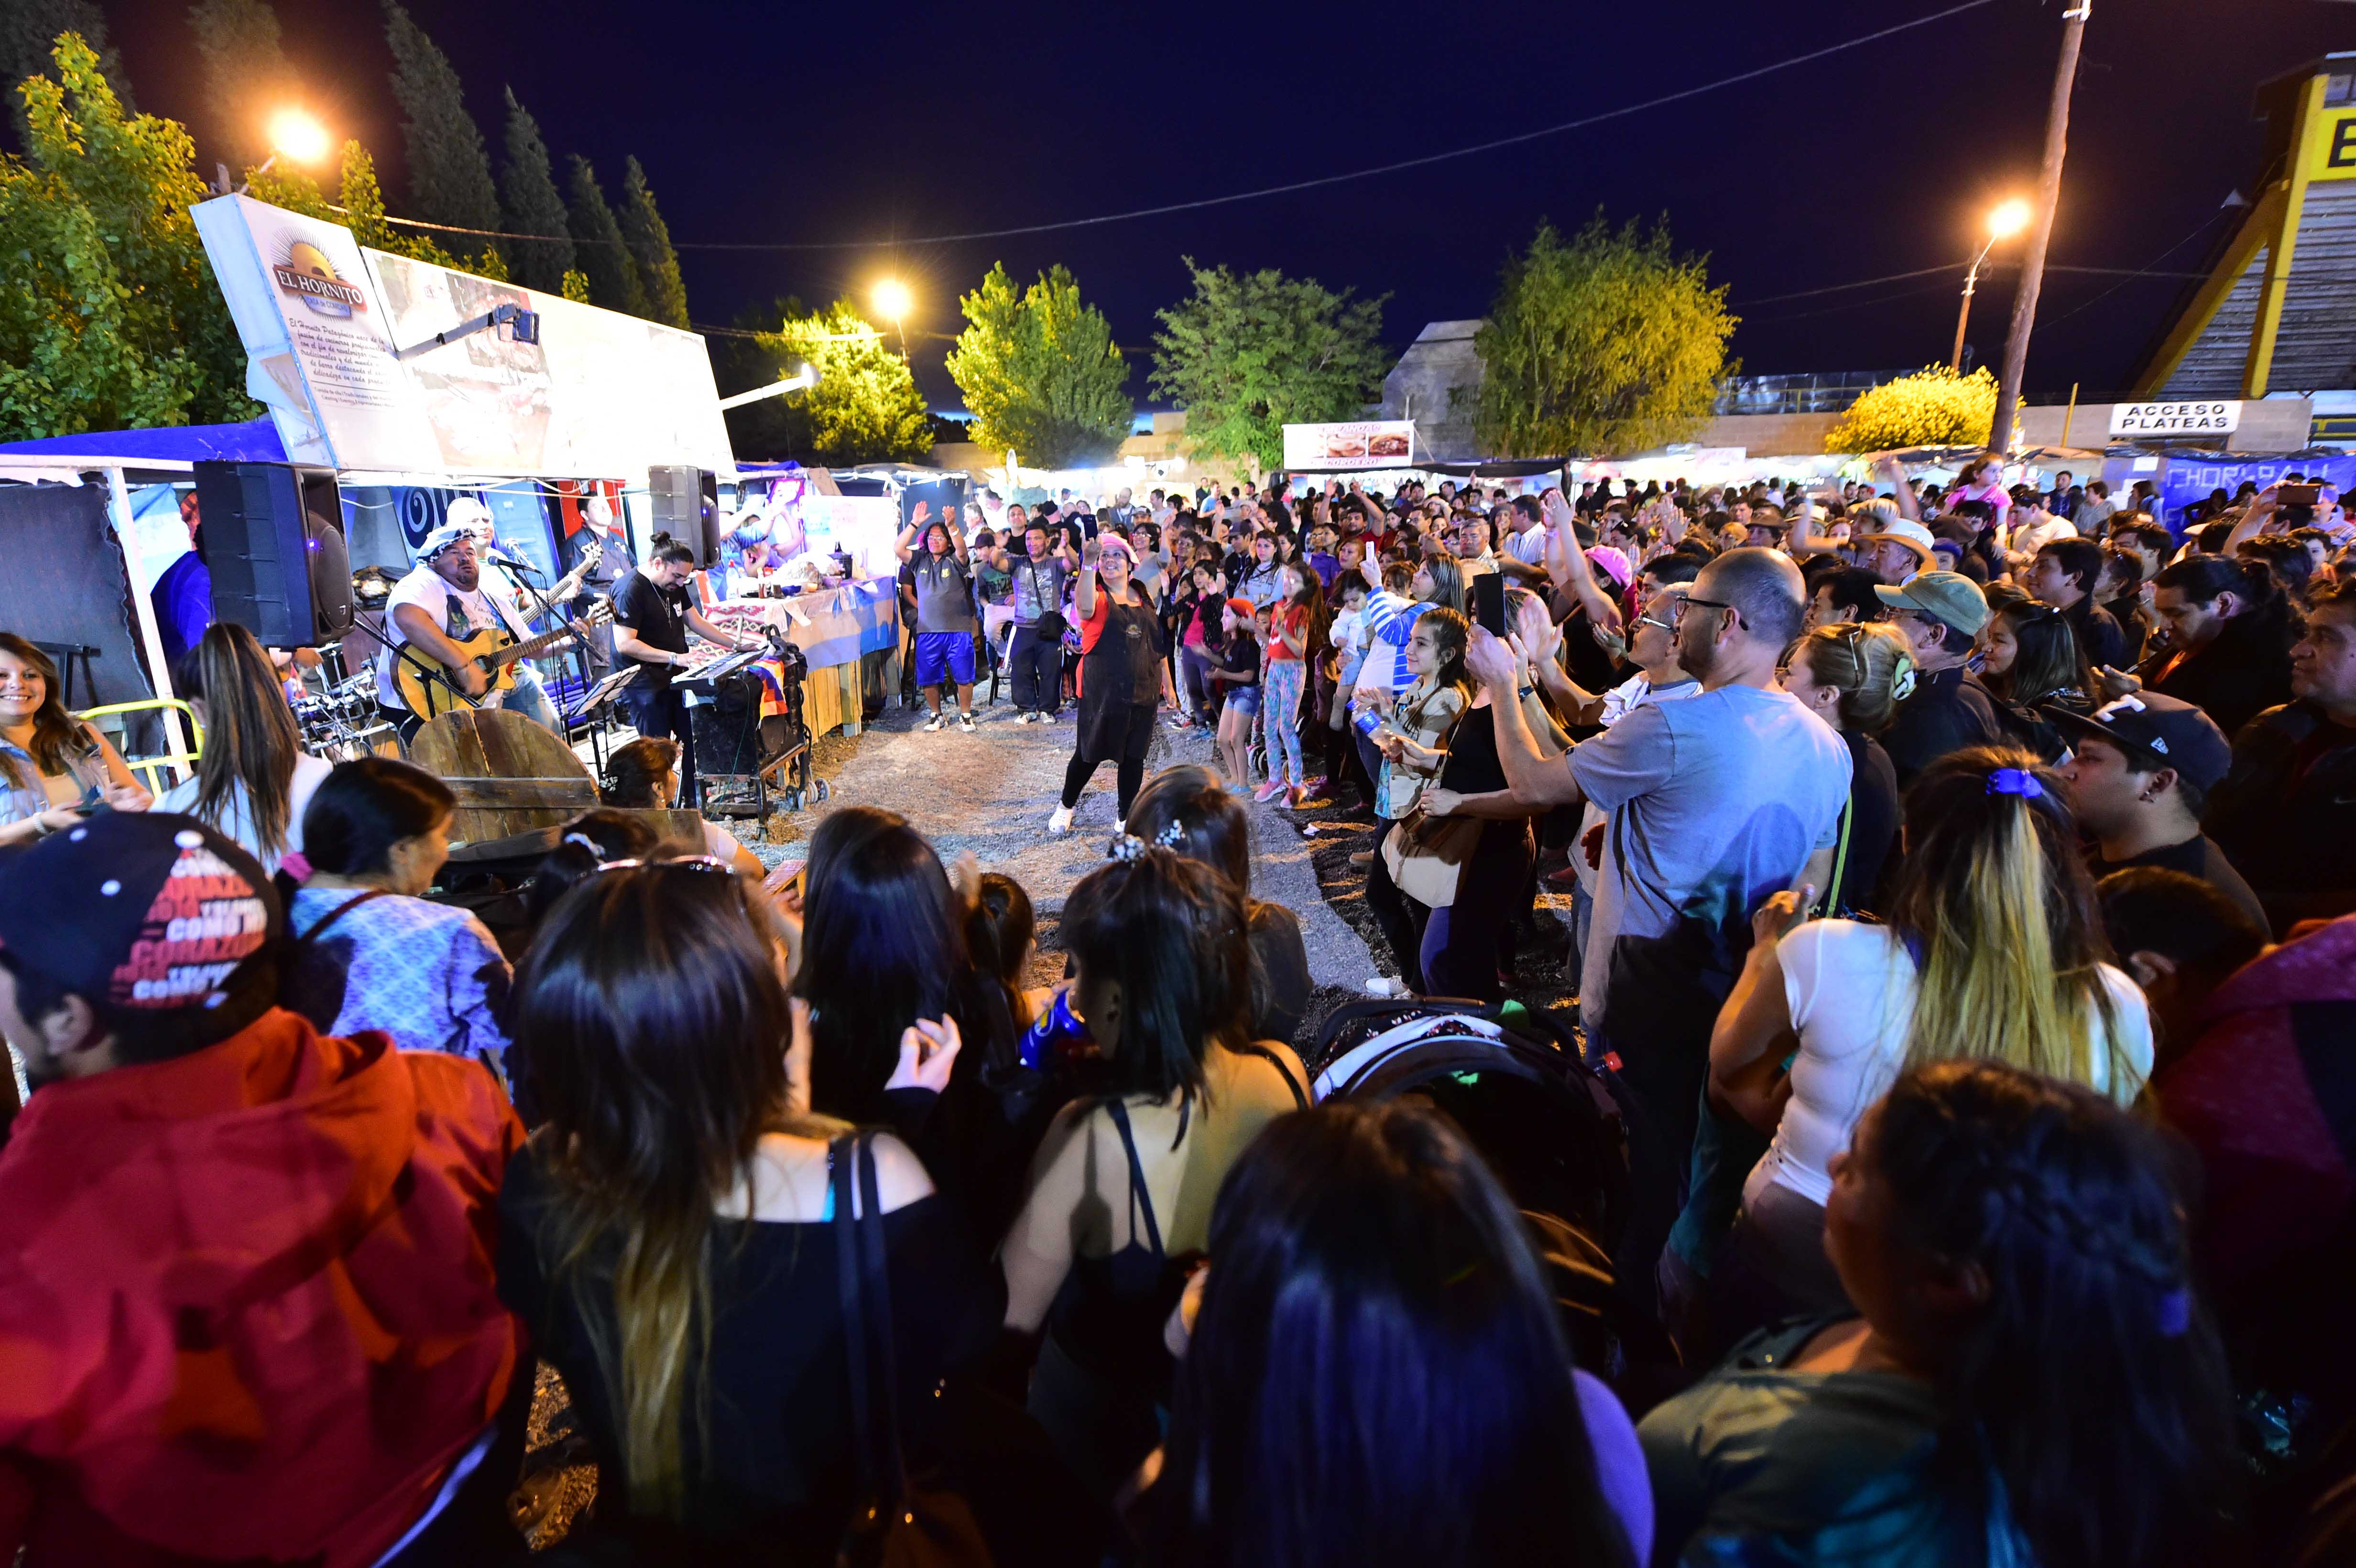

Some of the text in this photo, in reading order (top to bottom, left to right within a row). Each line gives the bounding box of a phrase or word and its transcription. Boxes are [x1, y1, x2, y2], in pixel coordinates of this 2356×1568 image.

[277, 270, 363, 305] EL HORNITO
[289, 317, 297, 327] El
[297, 320, 321, 332] Hornito
[344, 356, 352, 364] del
[335, 363, 365, 374] destacando
[2127, 404, 2225, 416] ACCESO
[2122, 417, 2228, 428] PLATEAS
